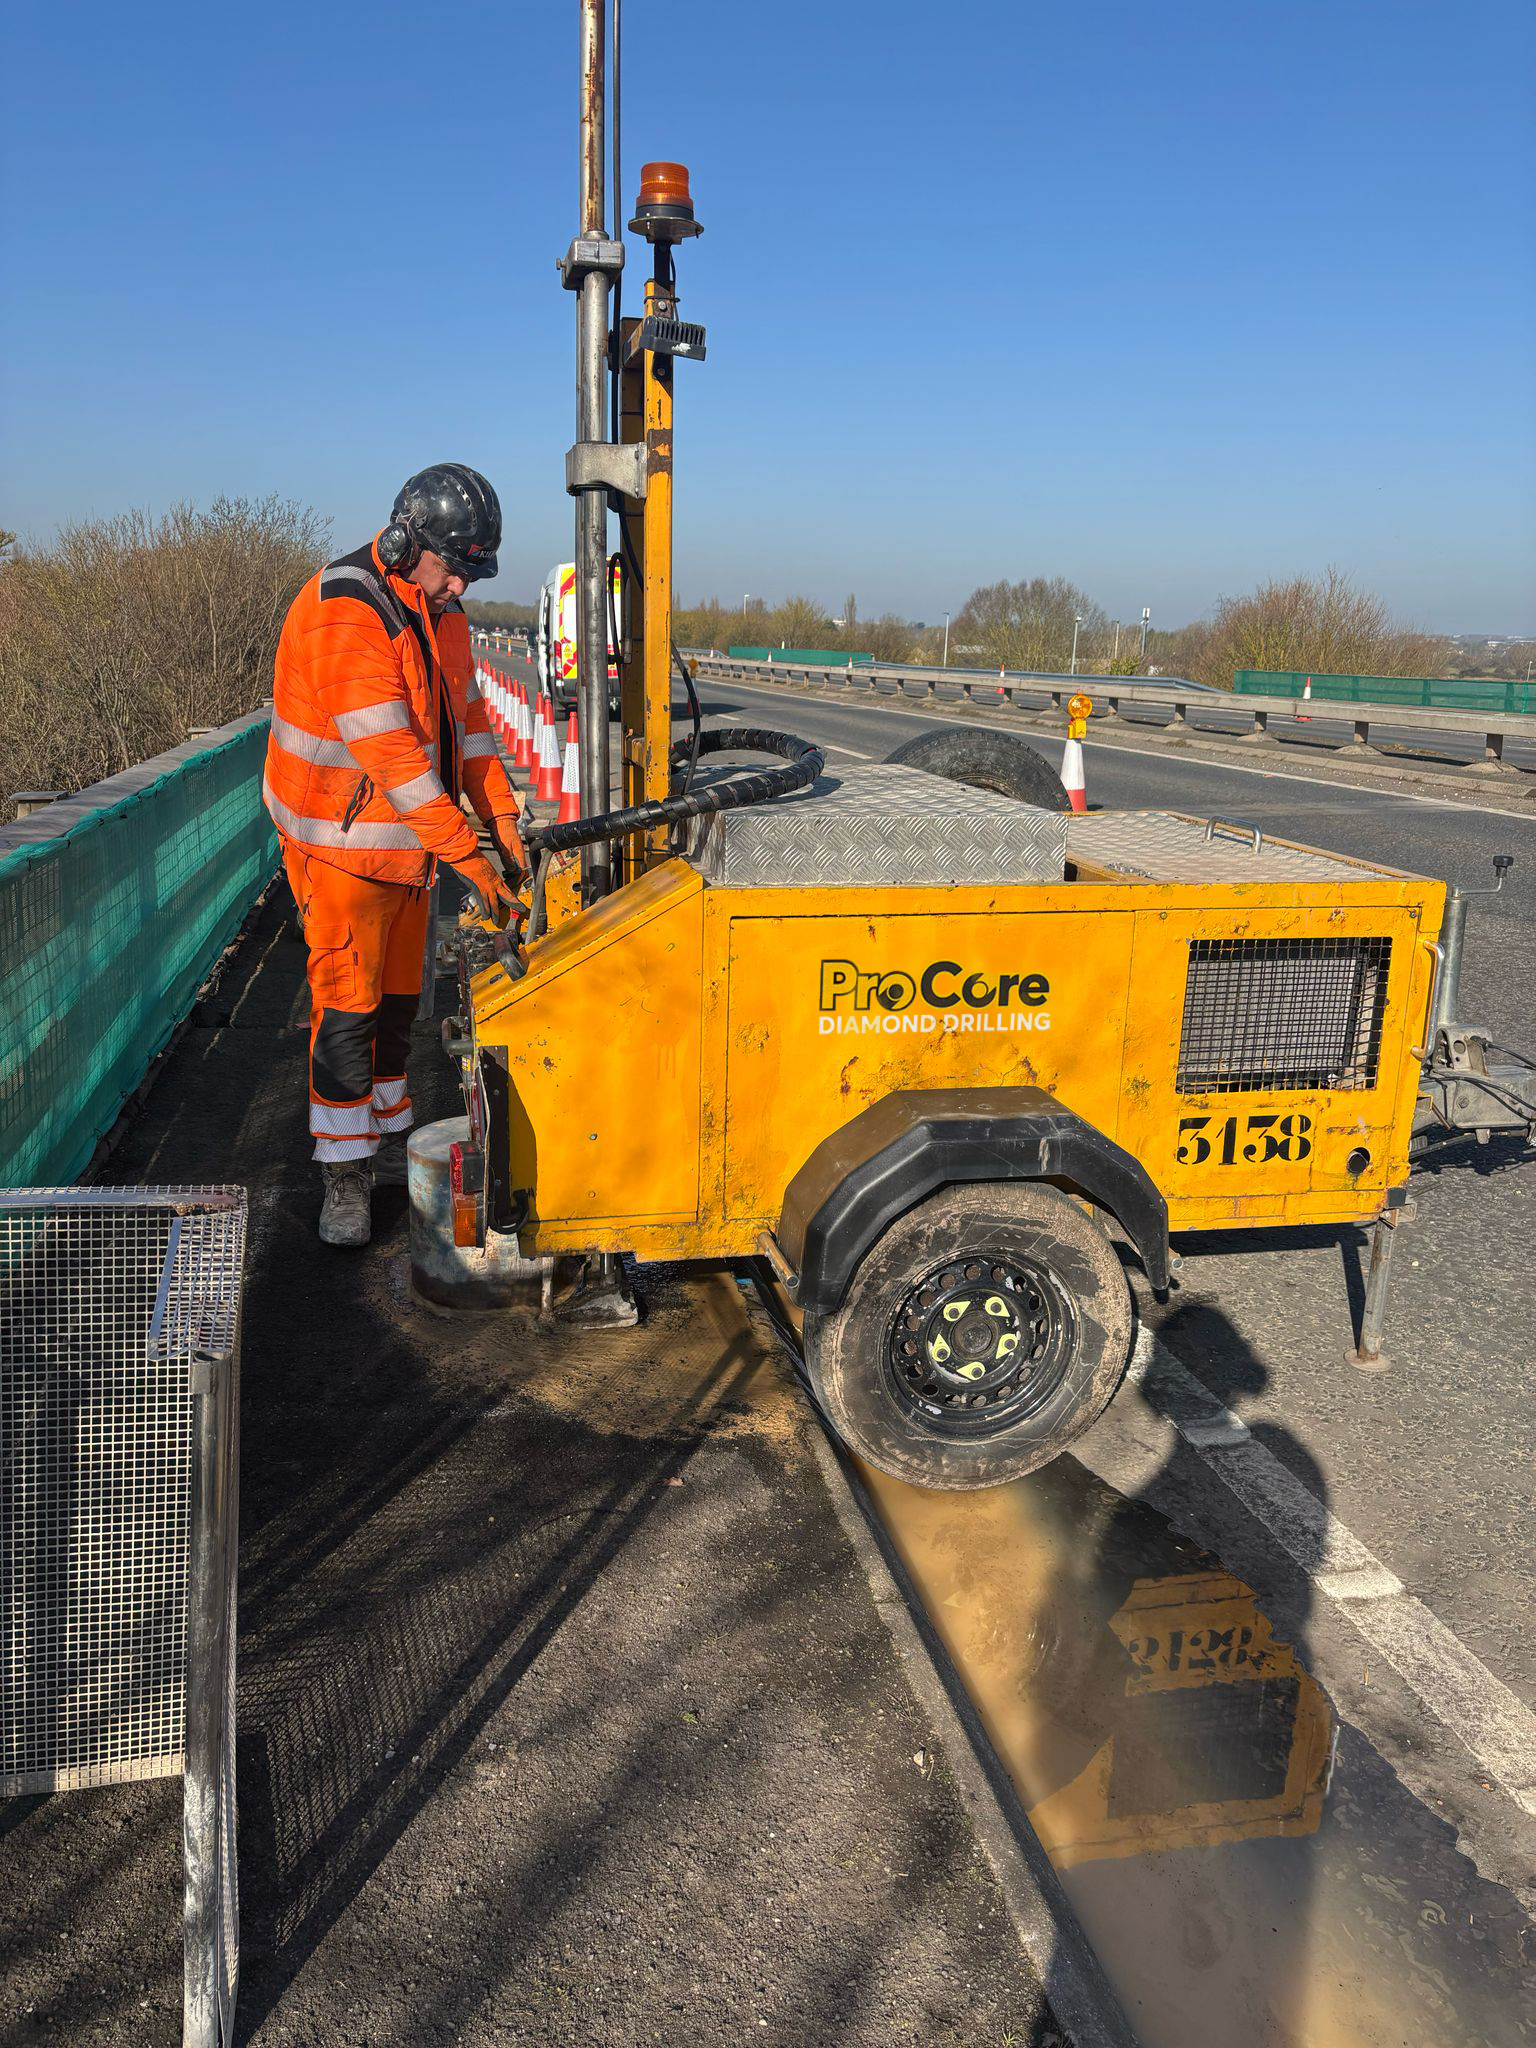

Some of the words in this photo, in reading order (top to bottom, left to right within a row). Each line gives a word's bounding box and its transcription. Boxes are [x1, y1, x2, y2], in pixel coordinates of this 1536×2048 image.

[818, 1014, 936, 1035] DIAMOND
[942, 1012, 1051, 1032] DRILLING
[1176, 1113, 1312, 1166] 3138
